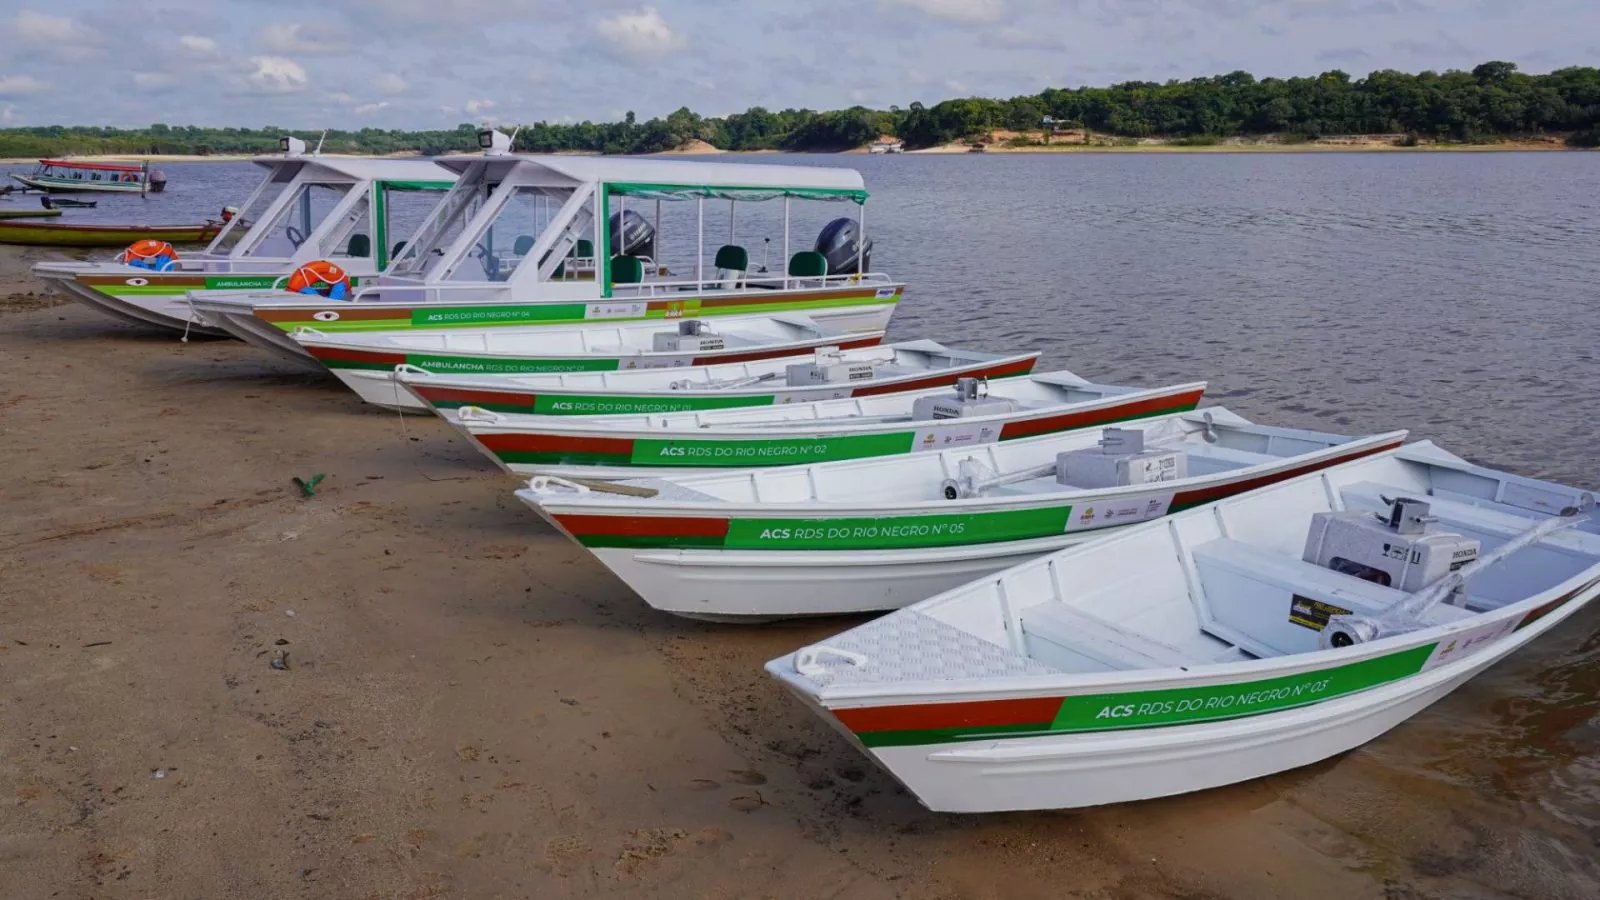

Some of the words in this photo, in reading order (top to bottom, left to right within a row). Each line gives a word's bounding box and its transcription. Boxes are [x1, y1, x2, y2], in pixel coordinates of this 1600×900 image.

[420, 361, 484, 370] AMBULANCHA
[934, 406, 959, 415] HONDA
[660, 447, 685, 456] ACS
[687, 447, 712, 456] RDS
[715, 447, 734, 456] DO
[736, 447, 756, 456] RIO
[758, 446, 797, 456] NEGRO
[814, 445, 827, 454] 02
[760, 528, 790, 539] ACS
[794, 528, 824, 539] RDS
[827, 527, 850, 539] DO
[853, 526, 878, 538] RIO
[880, 525, 929, 537] NEGRO
[949, 523, 965, 534] 05
[1452, 548, 1477, 559] HONDA
[1096, 703, 1136, 719] ACS
[1137, 700, 1174, 716] RDS
[1176, 698, 1203, 713] DO
[1205, 695, 1235, 710] RIO
[1236, 686, 1292, 705] NEGRO
[1311, 679, 1329, 693] 03
